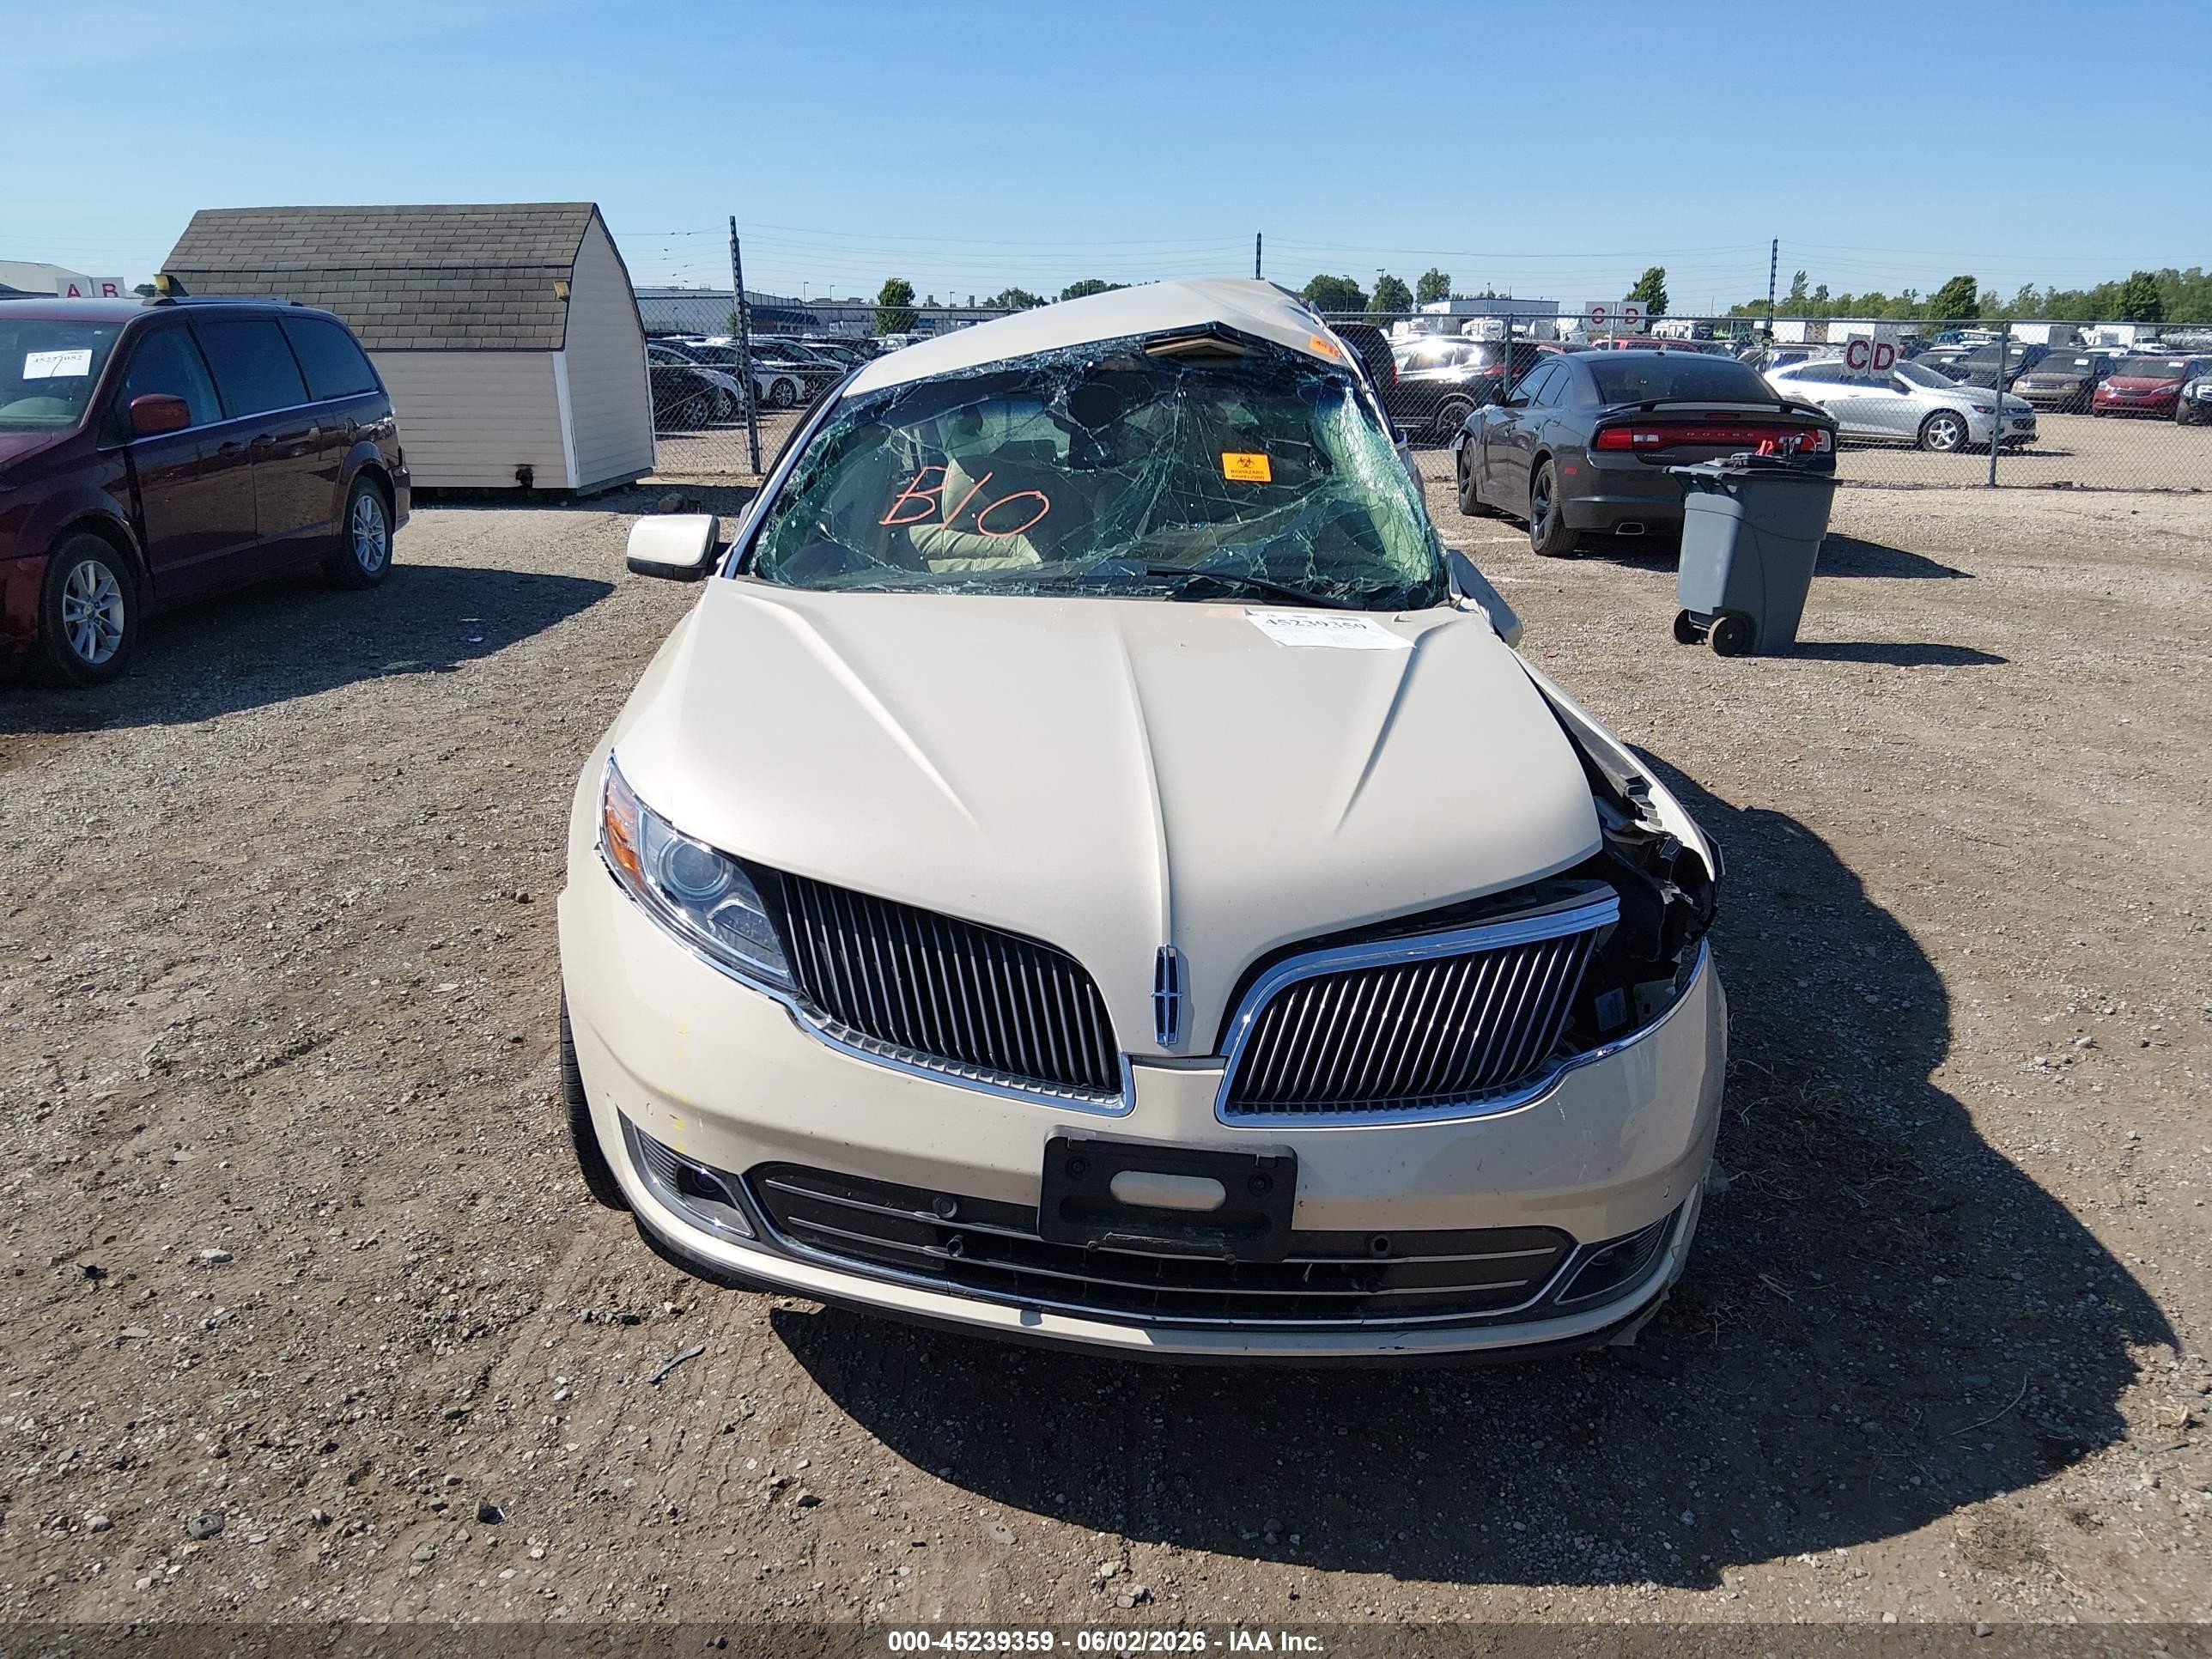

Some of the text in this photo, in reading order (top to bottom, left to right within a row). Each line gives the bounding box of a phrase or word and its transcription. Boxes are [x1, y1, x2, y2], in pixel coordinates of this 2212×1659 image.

[68, 283, 118, 298] A B
[1591, 307, 1639, 325] C D
